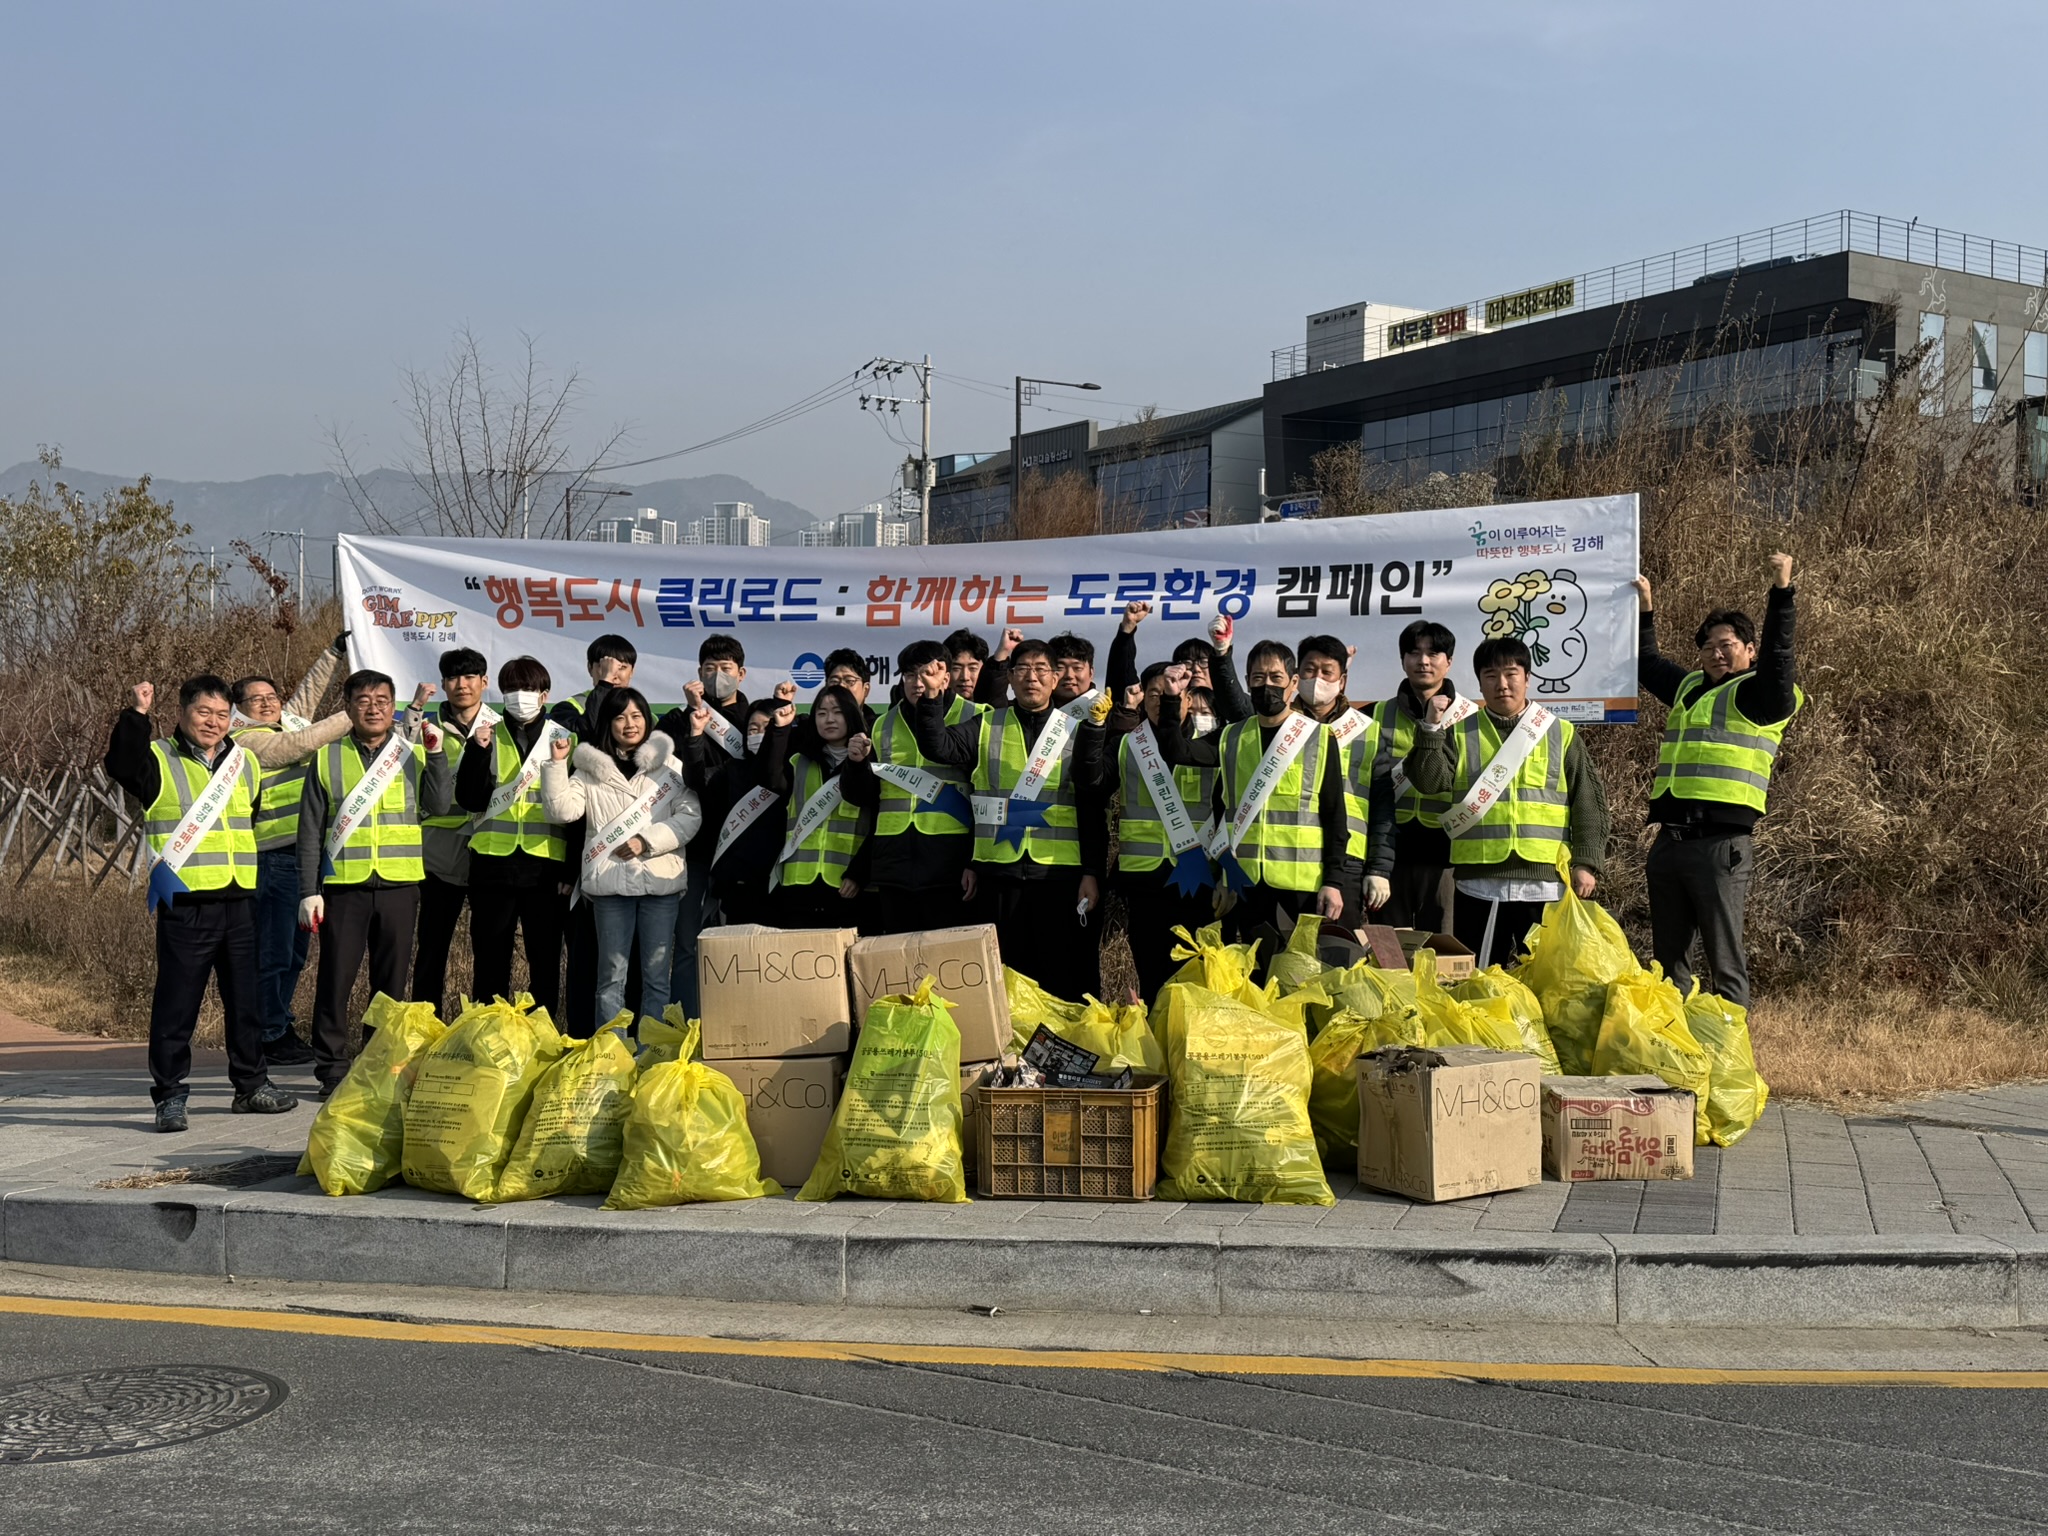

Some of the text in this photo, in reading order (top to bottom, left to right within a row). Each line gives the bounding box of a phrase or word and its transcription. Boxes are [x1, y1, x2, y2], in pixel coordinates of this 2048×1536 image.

[1488, 283, 1573, 324] 010-4588-4485
[1435, 309, 1468, 337] 임대
[1504, 525, 1567, 540] 이루어지는
[1476, 535, 1604, 560] 따뜻한 행복도시 김해
[362, 594, 401, 613] GIM
[656, 577, 823, 628] 클린로드
[866, 574, 1049, 627] 함께하는
[1064, 568, 1258, 620] 도로환경
[402, 631, 457, 642] 행복도시 김해
[1040, 736, 1057, 757] 환경
[1276, 718, 1307, 756] 함께하는
[376, 744, 404, 779] 함께하는
[1025, 756, 1047, 787] 캠페인
[1261, 755, 1281, 778] 도로
[208, 783, 226, 804] 도로
[363, 776, 380, 797] 도로
[640, 782, 672, 814] 함께하는
[1249, 778, 1267, 801] 환경
[195, 802, 214, 824] 환경
[348, 795, 367, 815] 환경
[1452, 788, 1492, 830] 행복도시
[623, 810, 643, 829] 도로
[173, 822, 200, 854] 캠페인
[606, 825, 625, 844] 환경
[703, 949, 841, 985] MH&Co.
[1581, 1126, 1663, 1166] 해물라면
